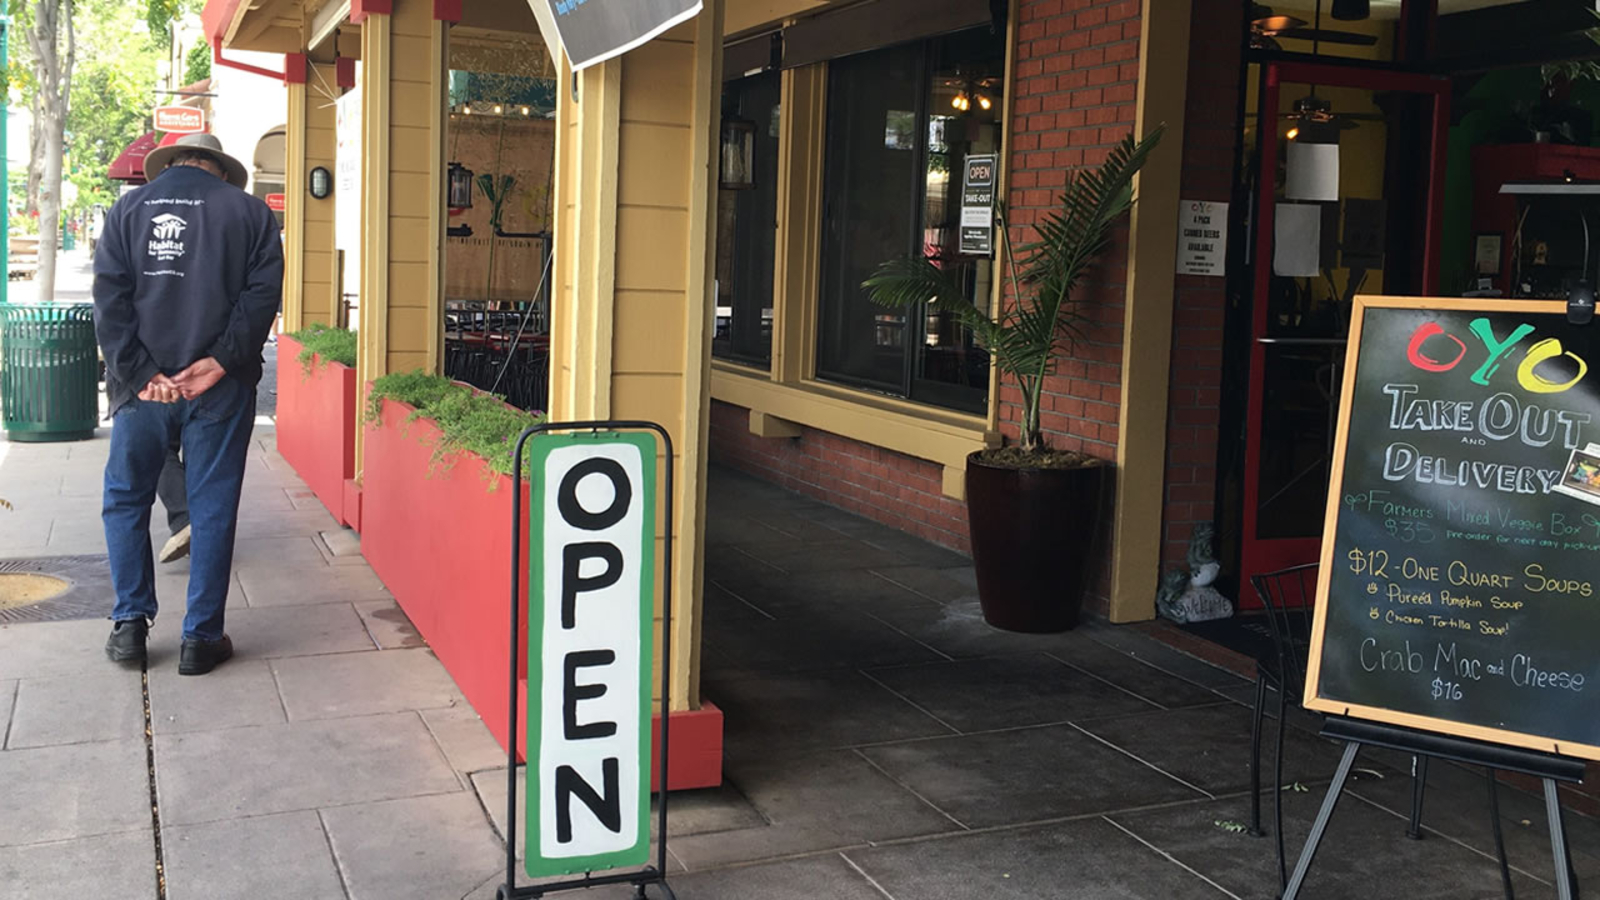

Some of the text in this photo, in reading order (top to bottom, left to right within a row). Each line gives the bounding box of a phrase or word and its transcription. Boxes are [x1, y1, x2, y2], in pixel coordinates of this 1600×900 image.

[969, 166, 991, 180] OPEN
[965, 193, 991, 203] TAKE-OUT
[149, 240, 184, 250] Habitat
[1407, 317, 1588, 394] OYO
[1382, 383, 1592, 450] TAKE OUT
[1460, 436, 1487, 447] AND
[1383, 442, 1561, 494] DELIVERY
[1446, 499, 1491, 527] Mixed
[1497, 507, 1544, 532] Veggie
[1551, 512, 1582, 536] Box
[1385, 518, 1436, 544] $35
[1448, 560, 1514, 588] QUART
[1524, 564, 1593, 597] SOUPS
[1440, 590, 1483, 609] Pumpkin
[1490, 596, 1524, 610] Soup
[1429, 614, 1471, 630] Tortilla
[1479, 620, 1510, 636] Soup!
[556, 456, 632, 844] OPEN
[1360, 637, 1585, 691] Crab Mac and Cheese
[1431, 676, 1463, 700] $16
